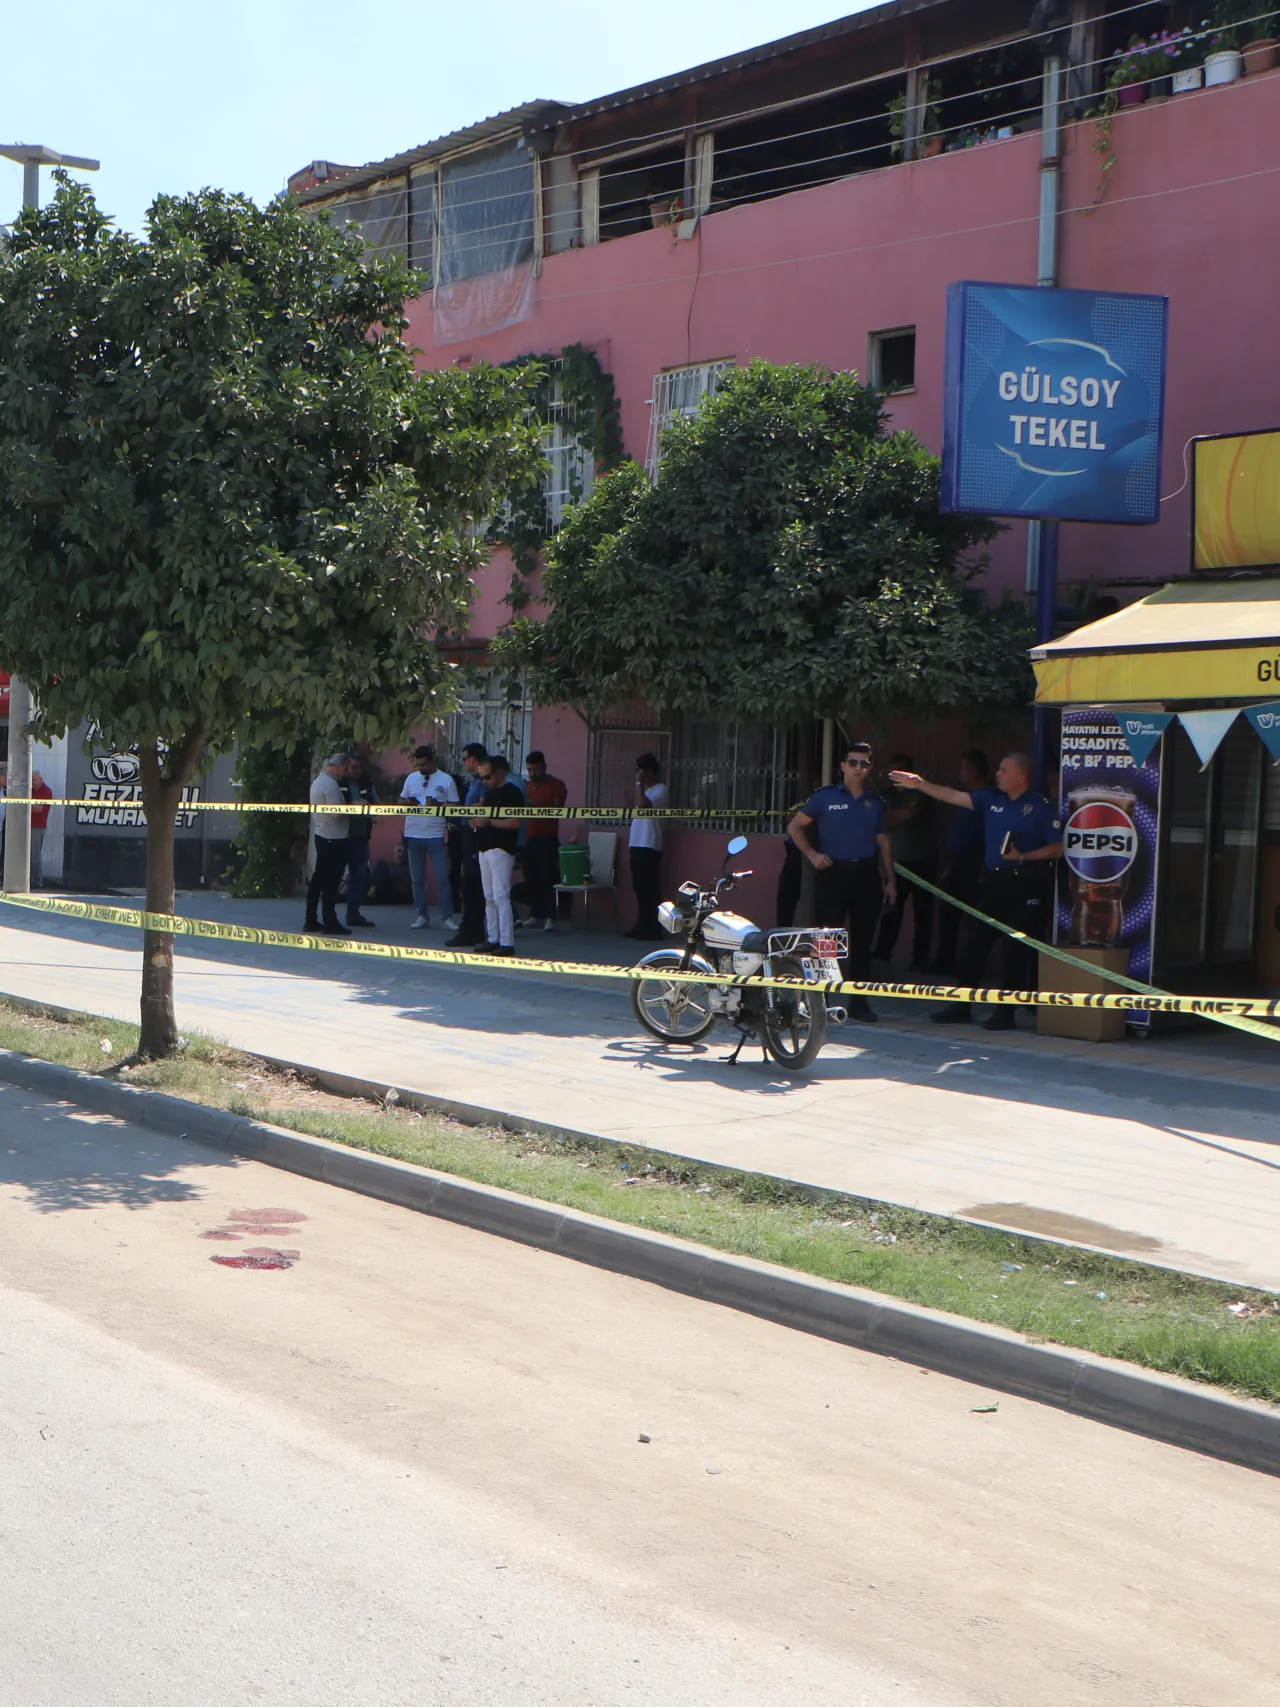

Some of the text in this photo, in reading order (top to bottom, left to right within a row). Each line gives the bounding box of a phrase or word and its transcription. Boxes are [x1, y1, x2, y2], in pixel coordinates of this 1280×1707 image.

[998, 366, 1121, 409] GÜLSOY
[1009, 414, 1106, 451] TEKEL
[1062, 725, 1100, 735] HAYATIN
[1061, 755, 1081, 770] AÇ
[1067, 832, 1133, 853] PEPSI
